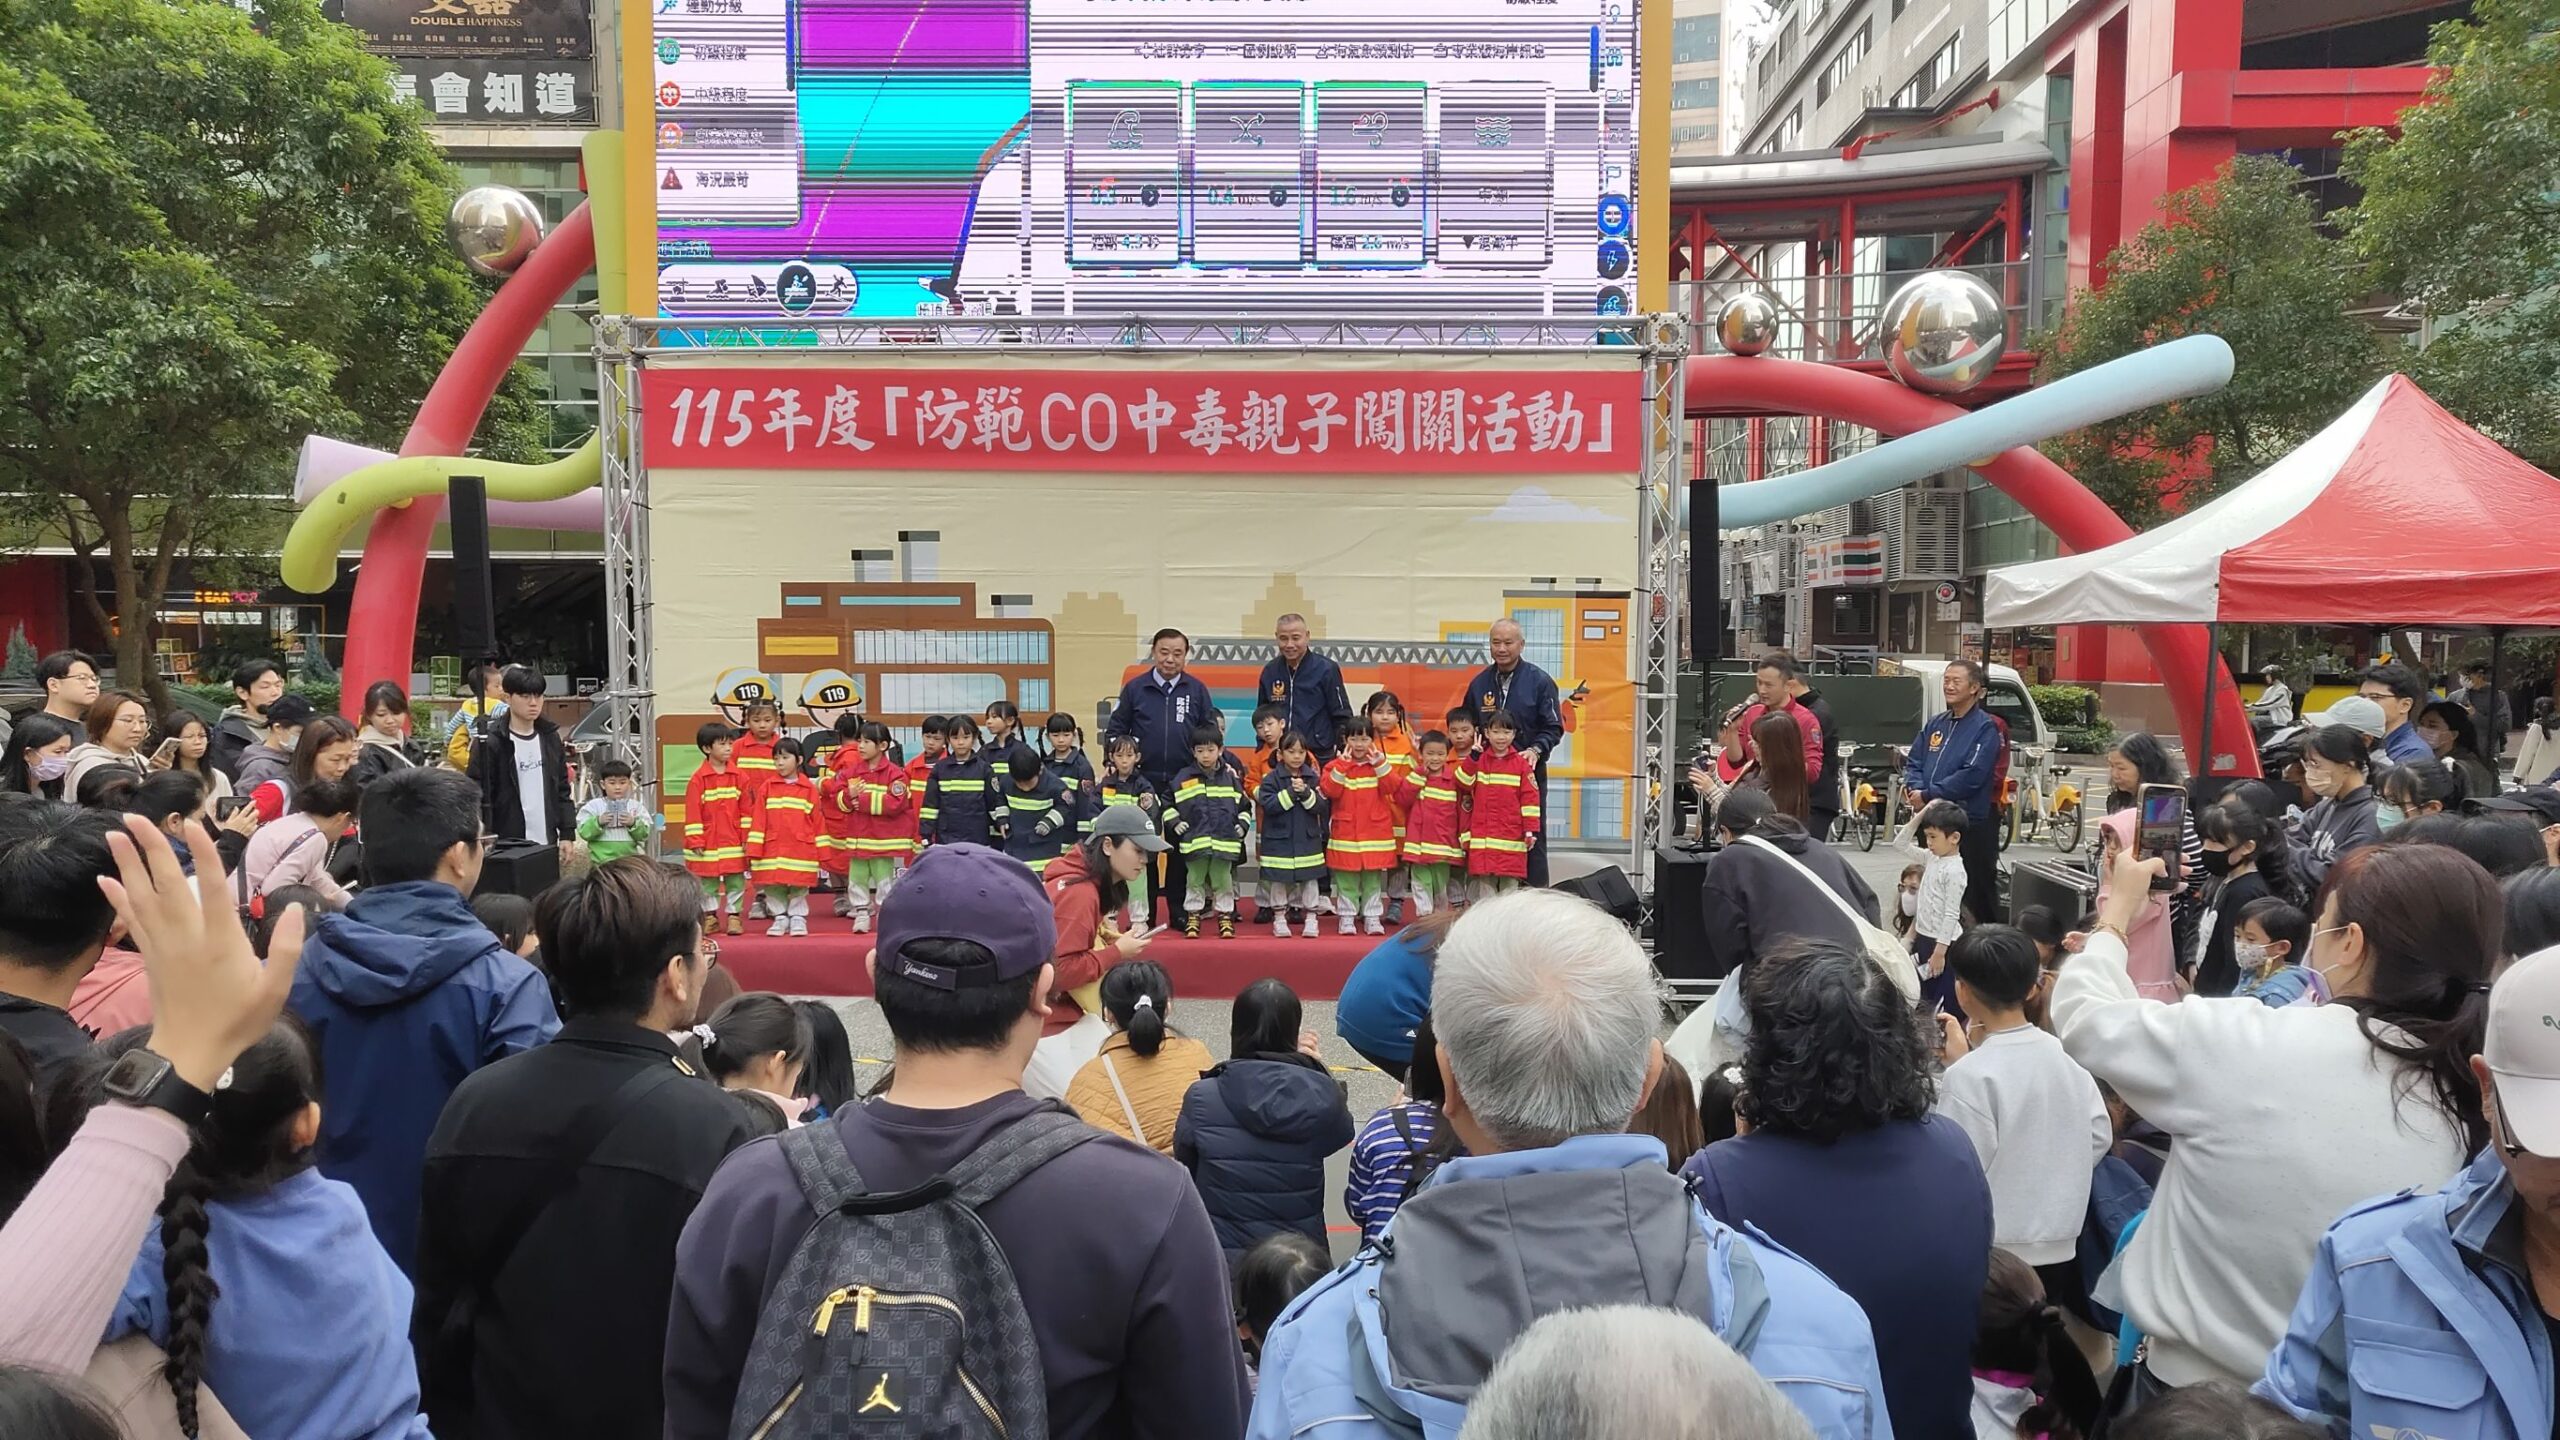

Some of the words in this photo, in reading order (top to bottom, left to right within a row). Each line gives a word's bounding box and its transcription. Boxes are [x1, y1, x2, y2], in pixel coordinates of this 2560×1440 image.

[410, 16, 465, 26] DOUBLE
[467, 17, 522, 27] HAPPINESS
[669, 384, 1613, 455] 115年度「防範CO中毒親子闖關活動」
[738, 685, 760, 699] 119
[825, 687, 846, 702] 119
